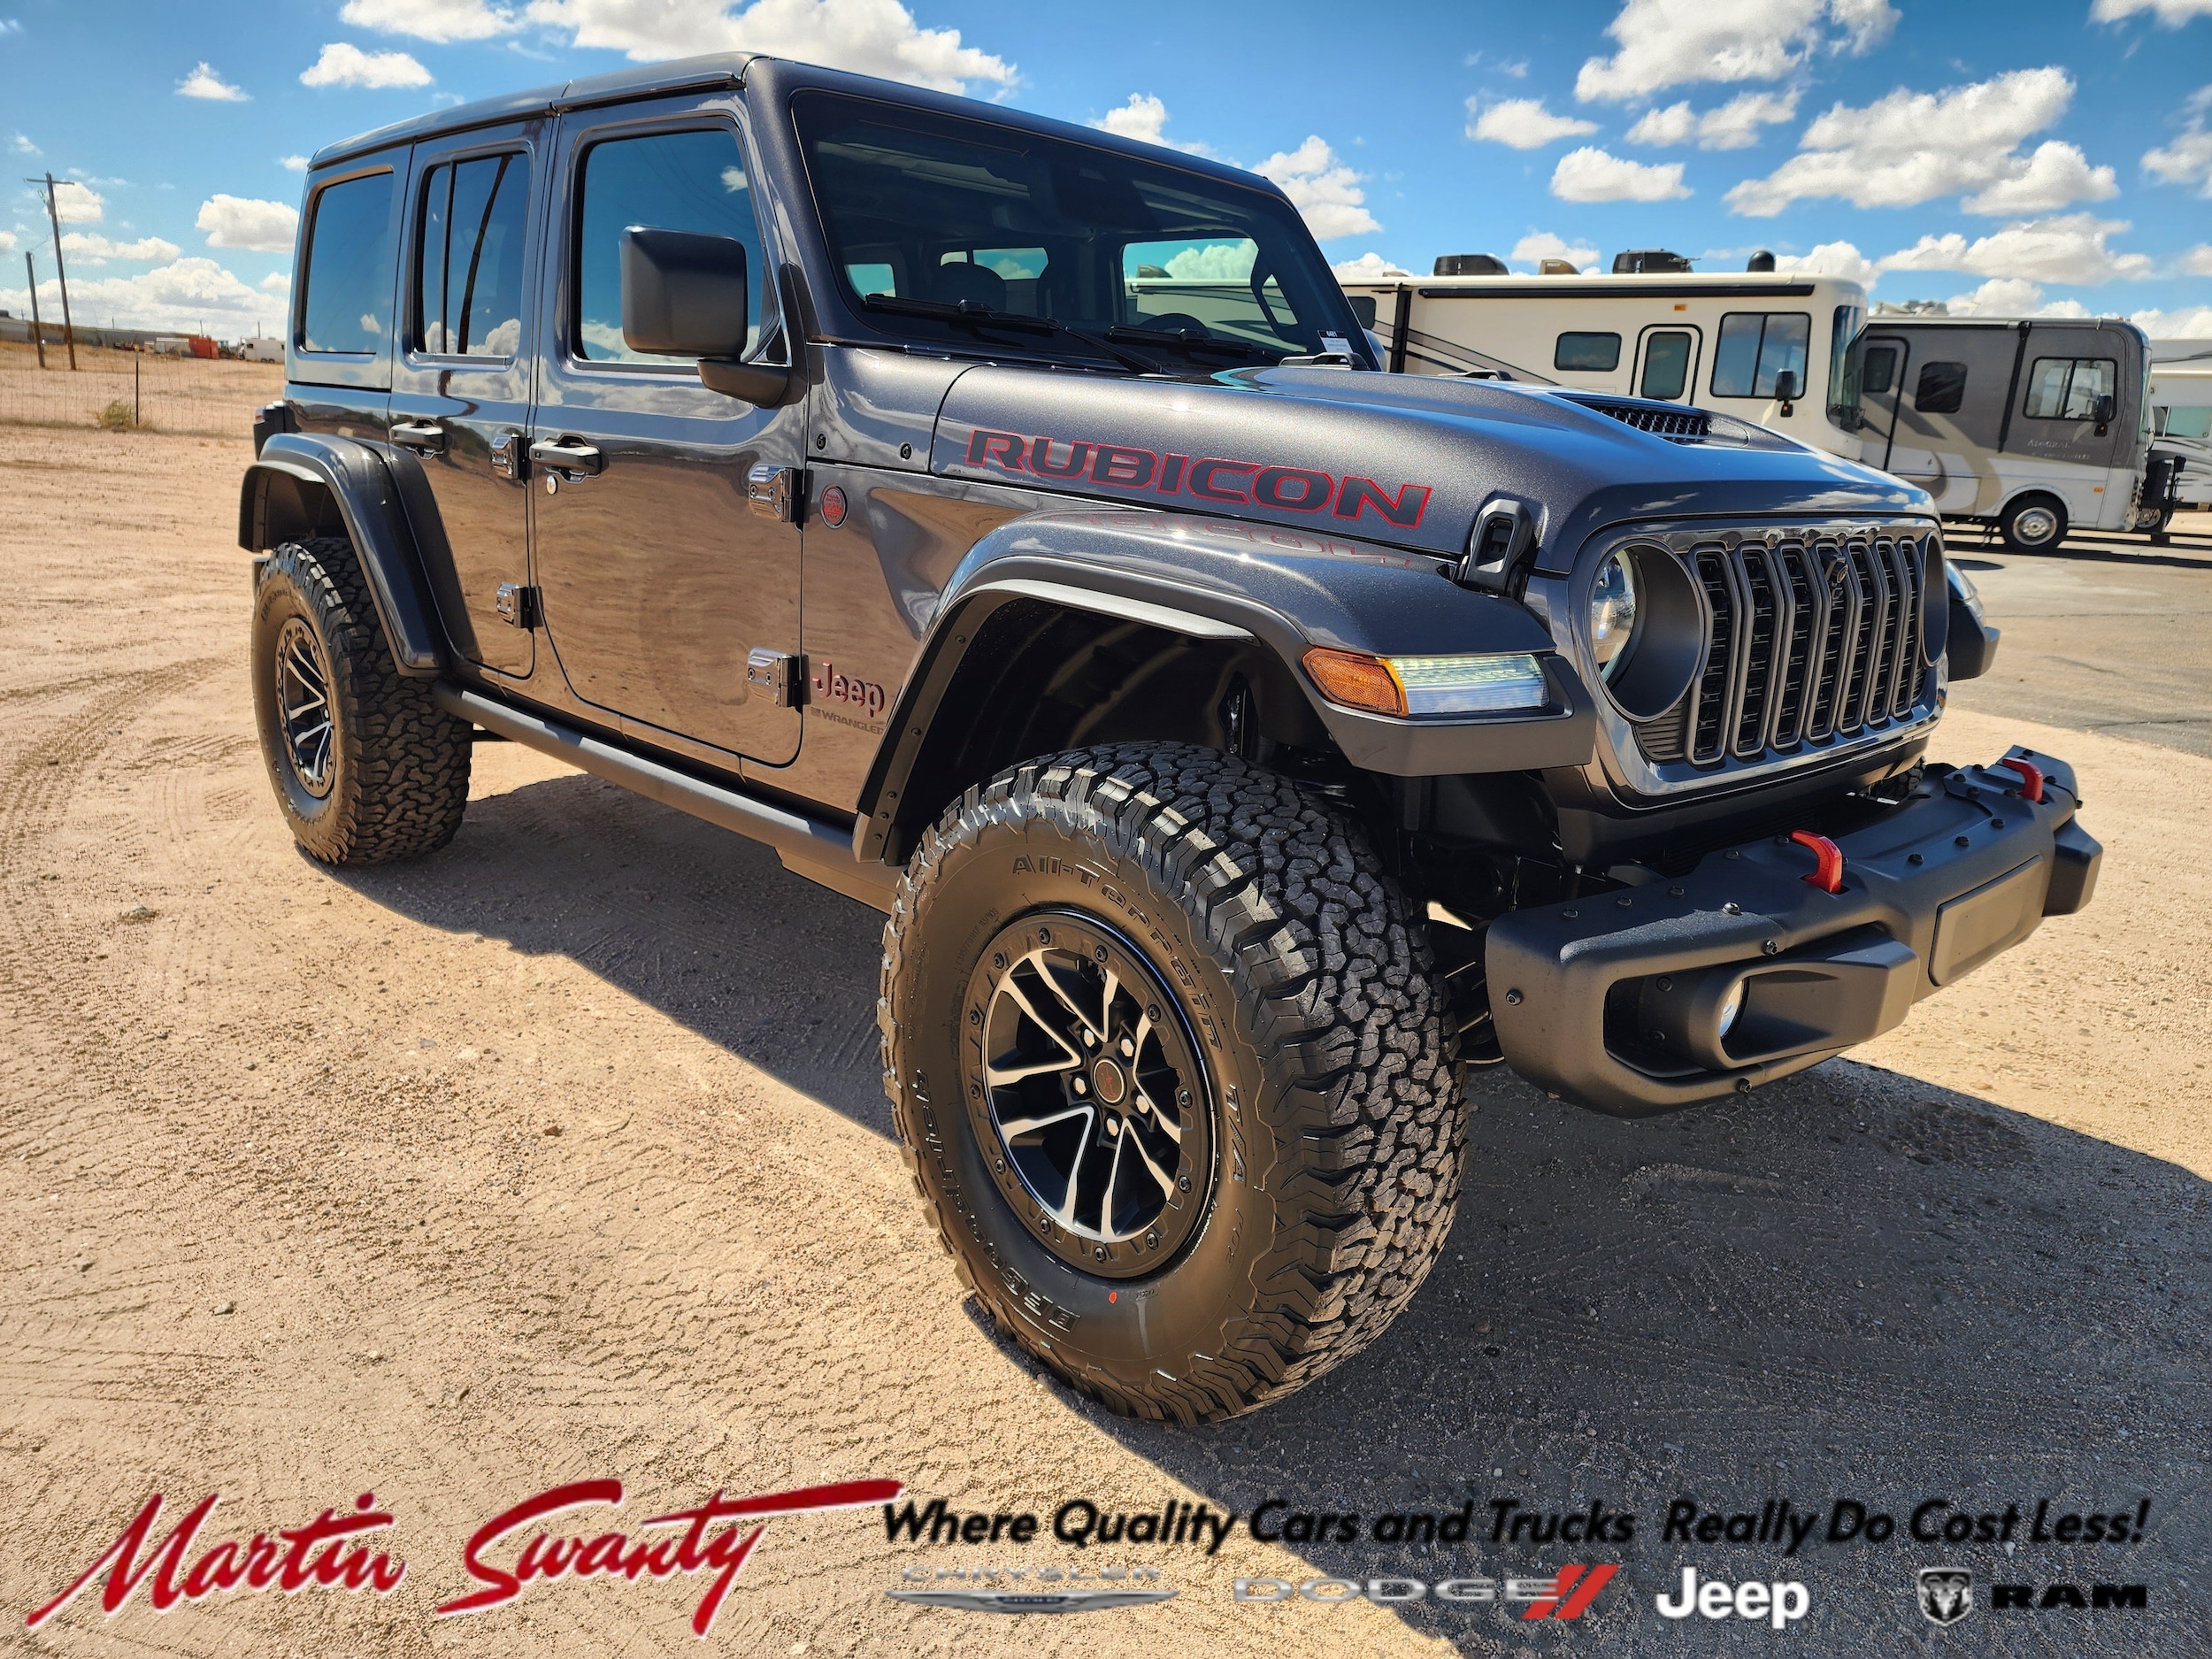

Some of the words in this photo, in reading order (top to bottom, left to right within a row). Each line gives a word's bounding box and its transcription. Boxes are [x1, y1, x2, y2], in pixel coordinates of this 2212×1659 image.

[965, 428, 1432, 529] RUBICON
[812, 661, 885, 718] Jeep
[821, 710, 885, 735] WRANGLER
